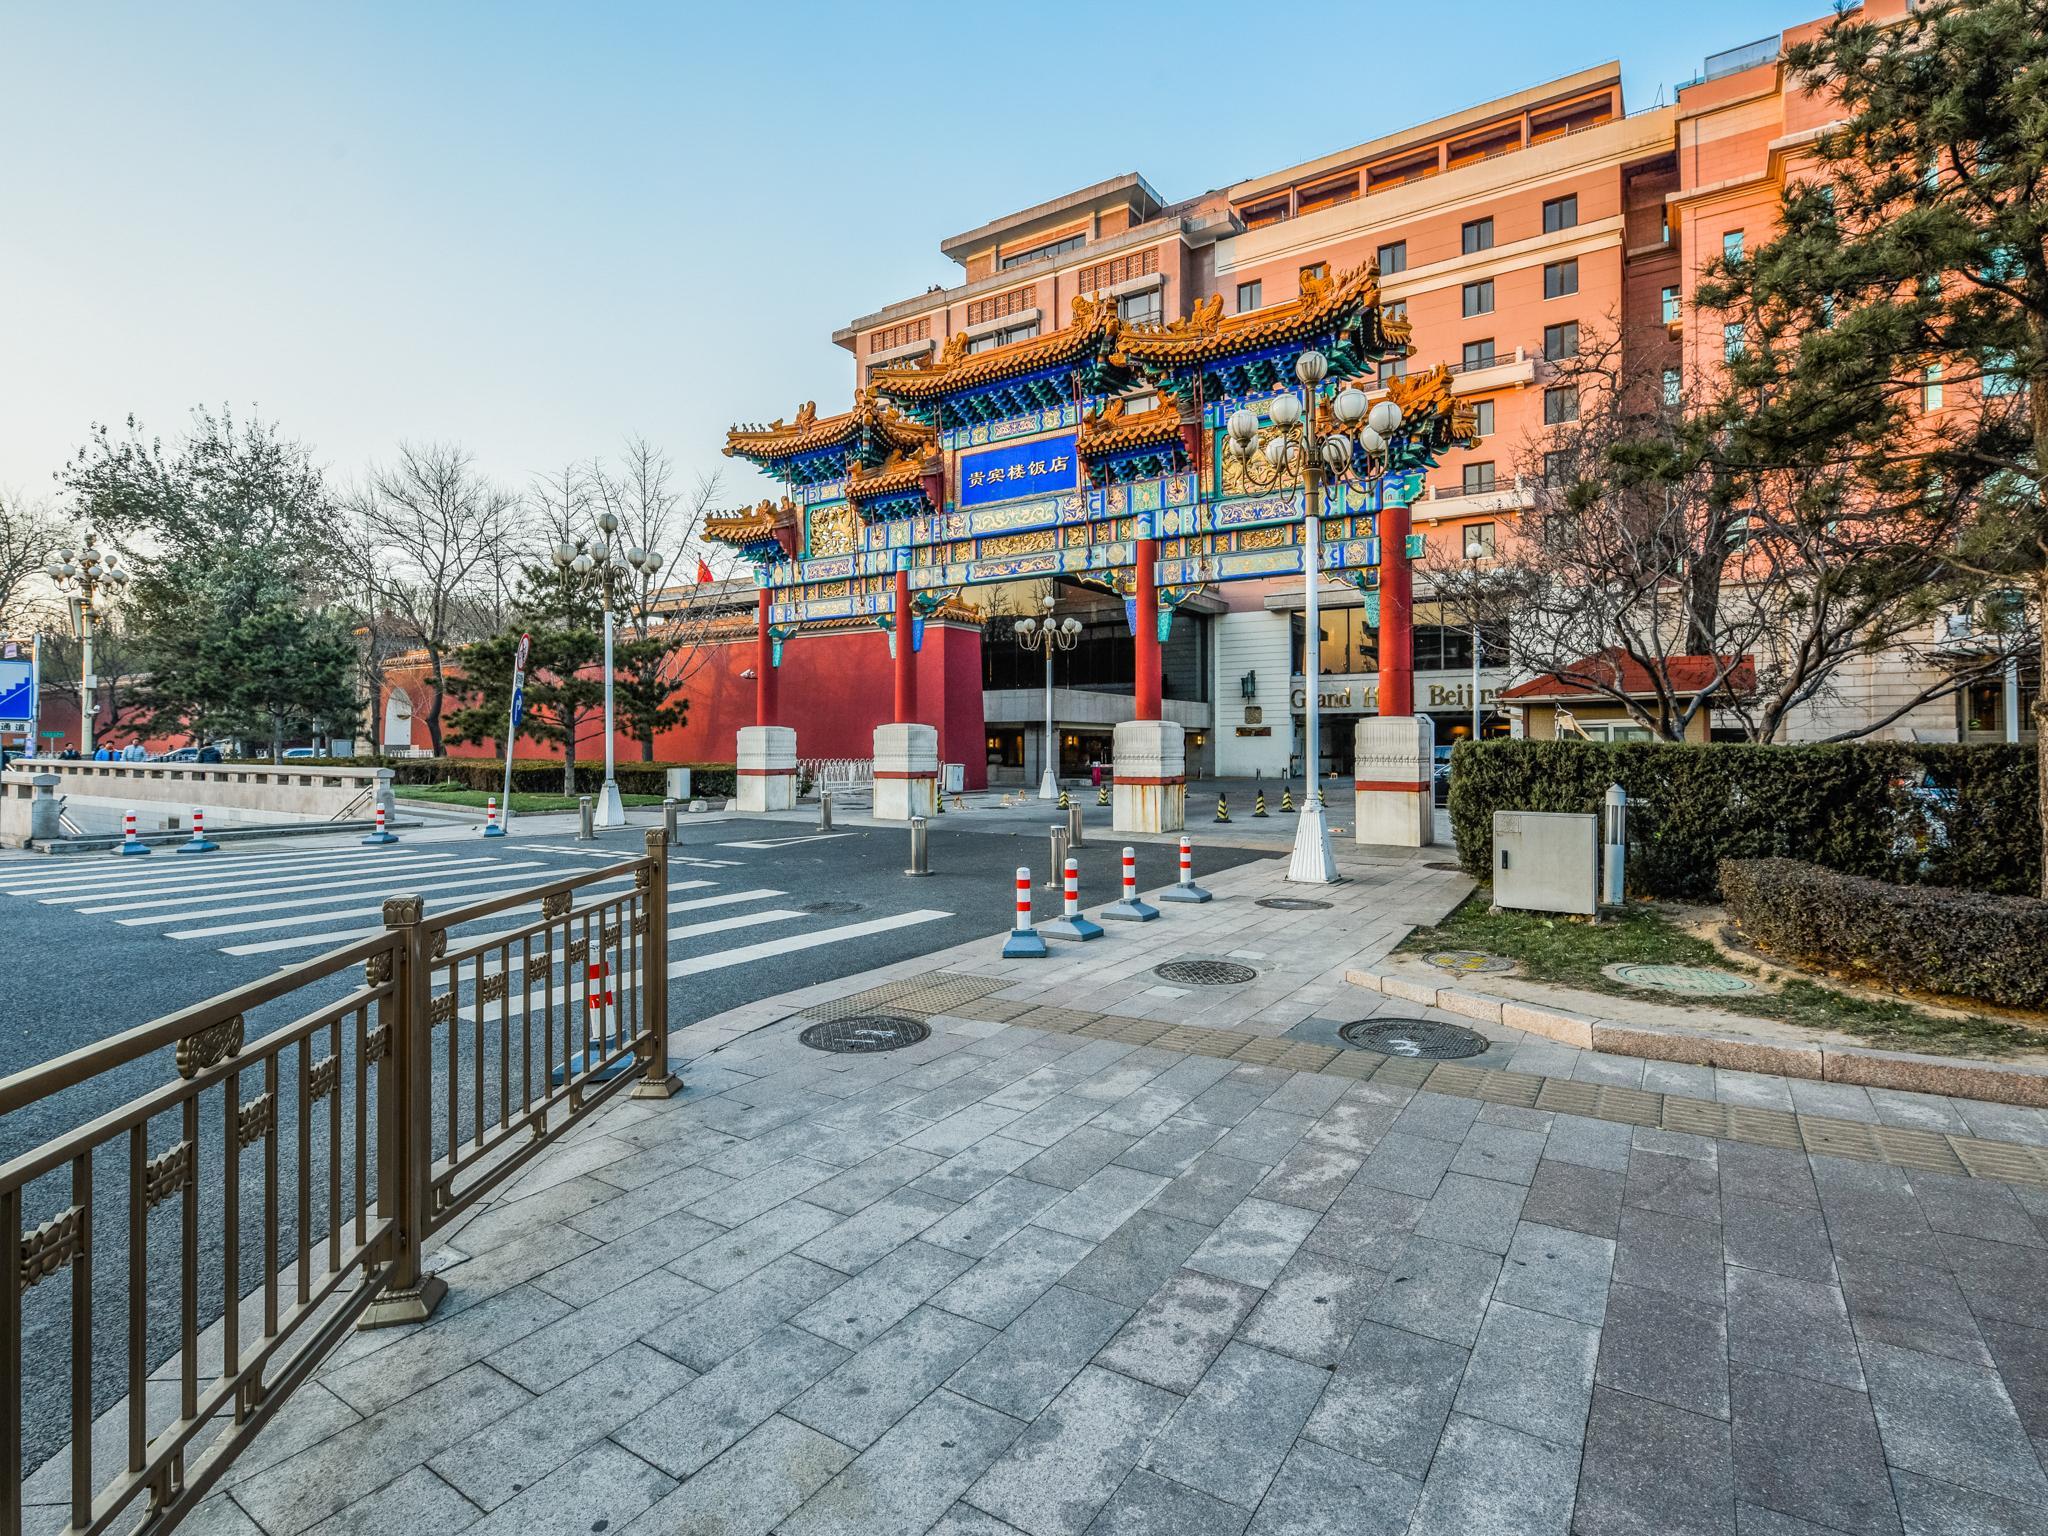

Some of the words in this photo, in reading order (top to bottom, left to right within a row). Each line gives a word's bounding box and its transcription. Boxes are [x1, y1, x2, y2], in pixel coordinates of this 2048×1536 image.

[968, 456, 1070, 487] 贵宾楼饭店
[1291, 686, 1352, 708] Gand
[1428, 683, 1506, 711] Beijn
[1, 722, 25, 731] 通道
